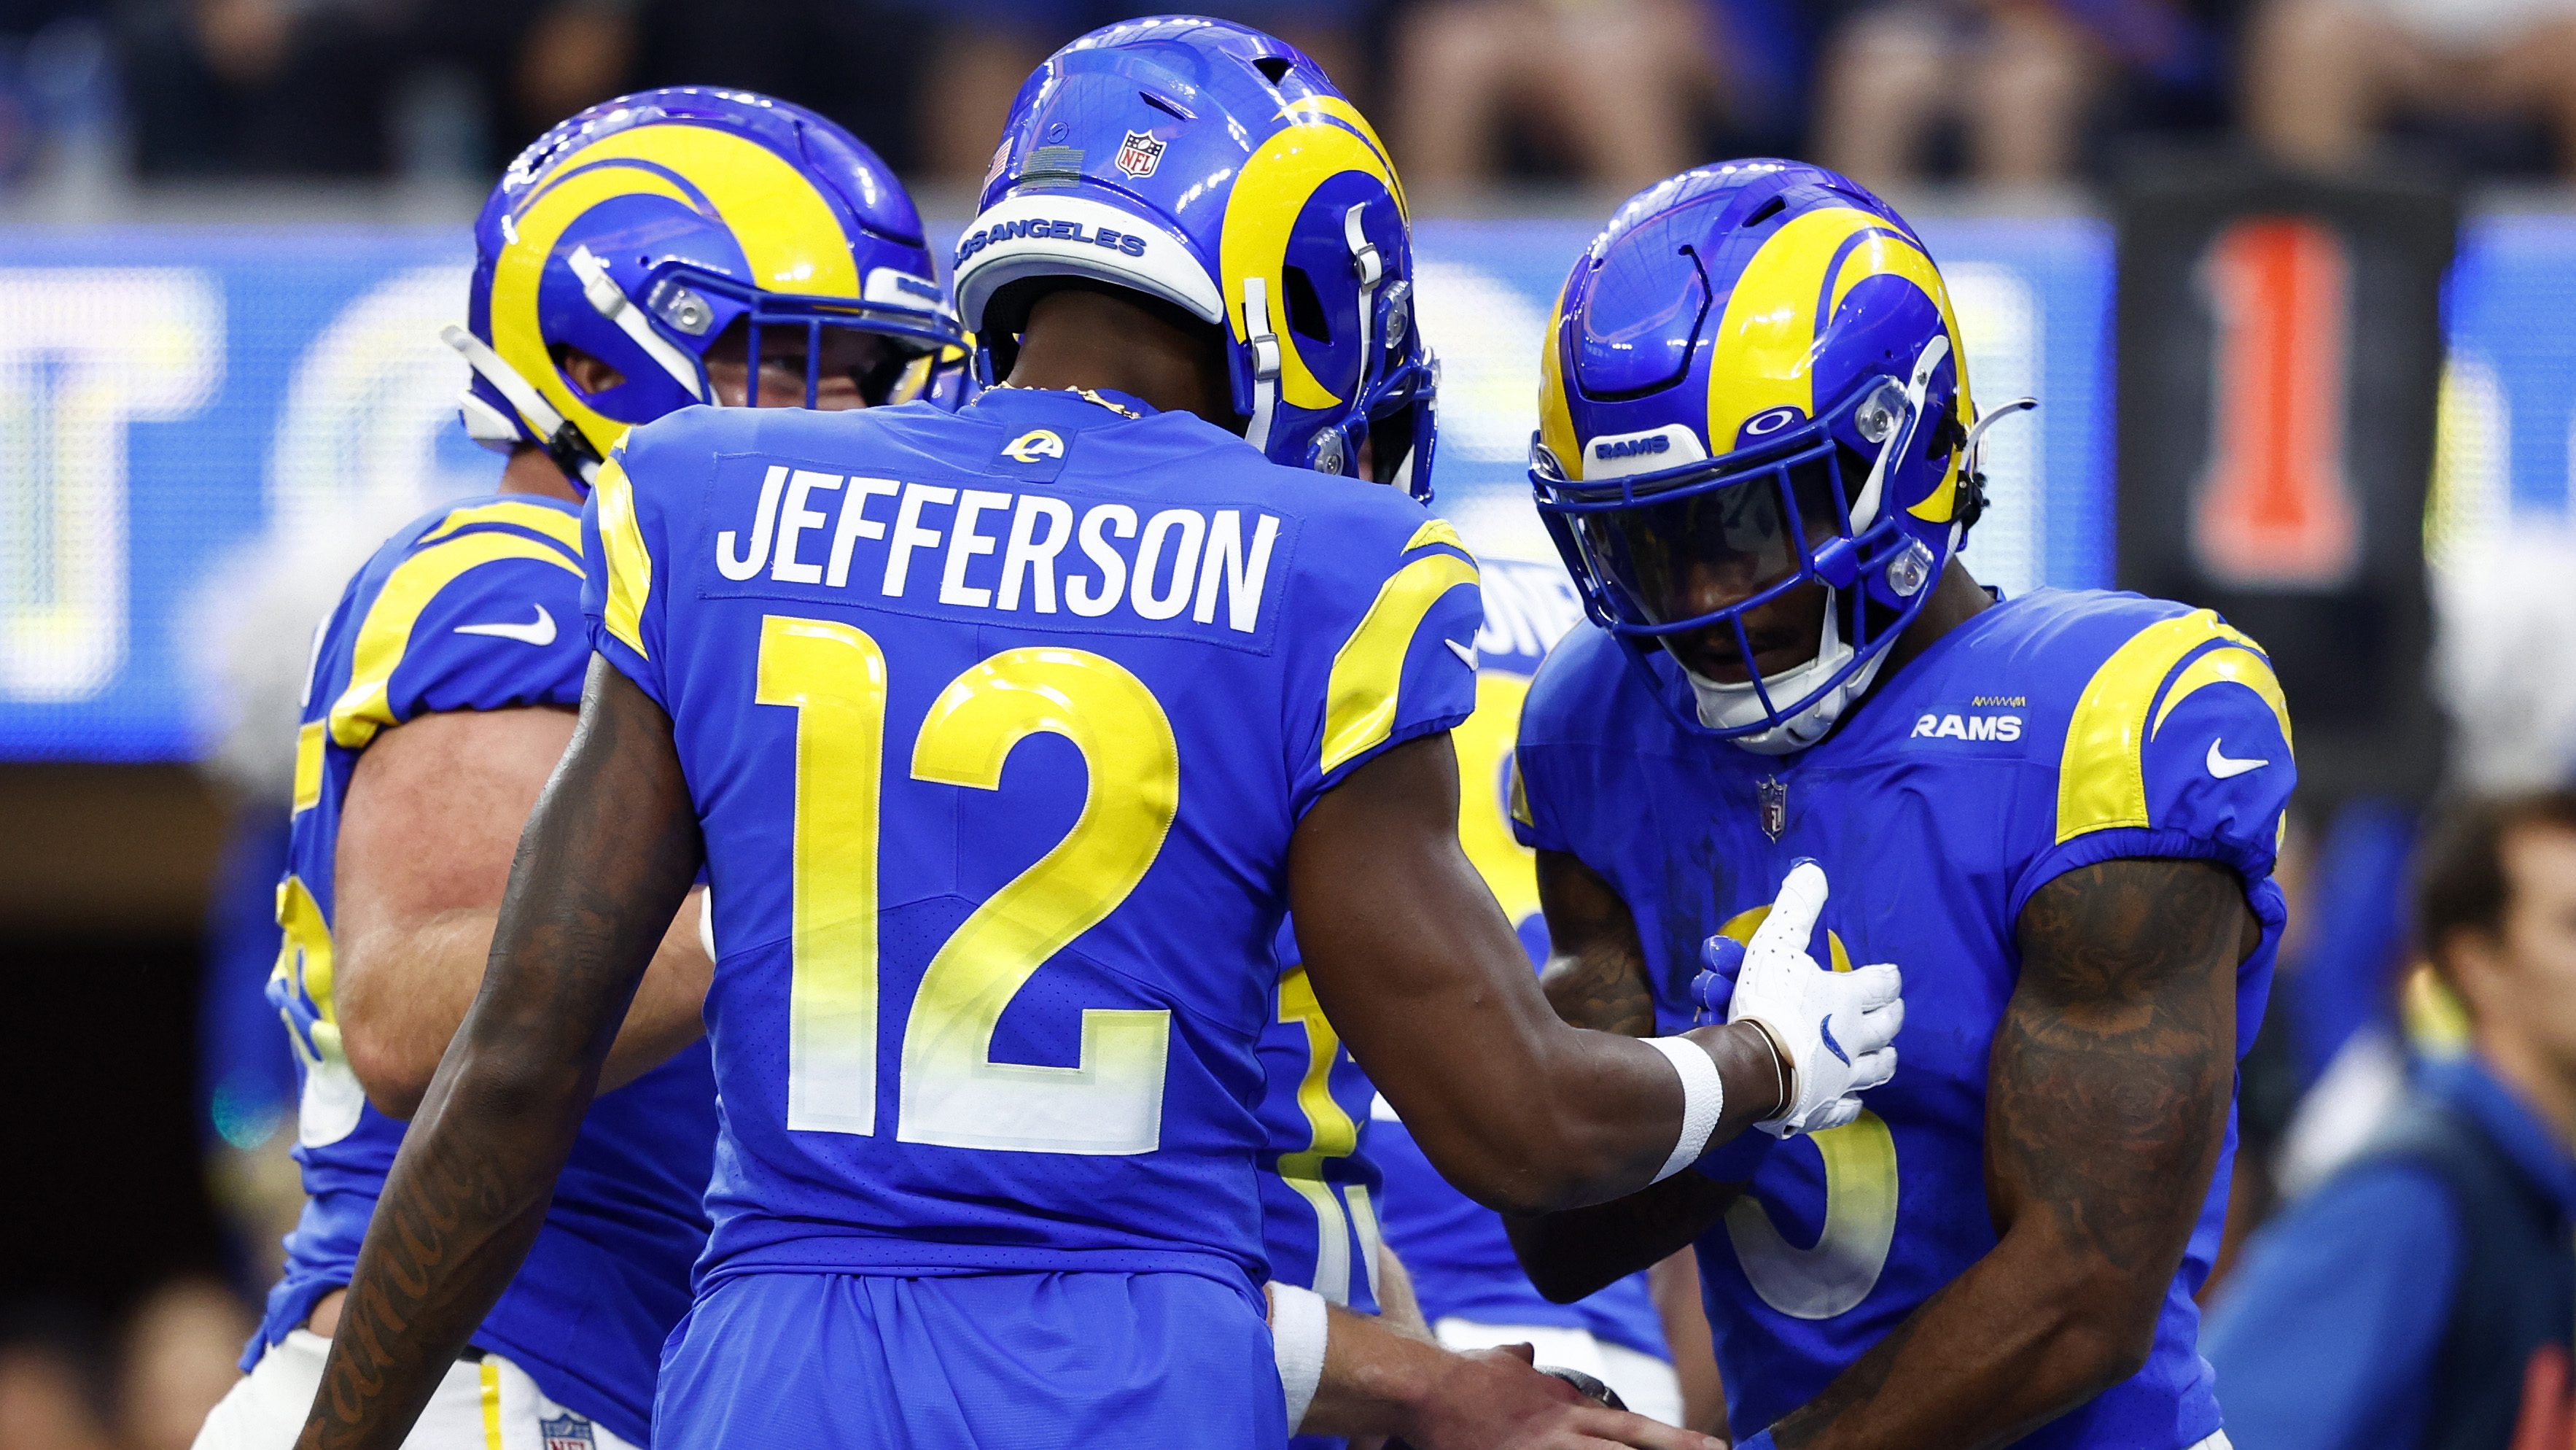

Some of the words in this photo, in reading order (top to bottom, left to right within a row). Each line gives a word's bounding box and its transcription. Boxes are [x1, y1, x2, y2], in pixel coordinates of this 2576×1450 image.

[1121, 148, 1151, 172] NFL
[987, 218, 1147, 257] ANGELES
[2195, 214, 2359, 584] 1
[1595, 434, 1670, 460] RAMS
[715, 465, 1281, 635] JEFFERSON
[1910, 713, 2023, 743] RAMS
[755, 614, 1180, 1156] 12
